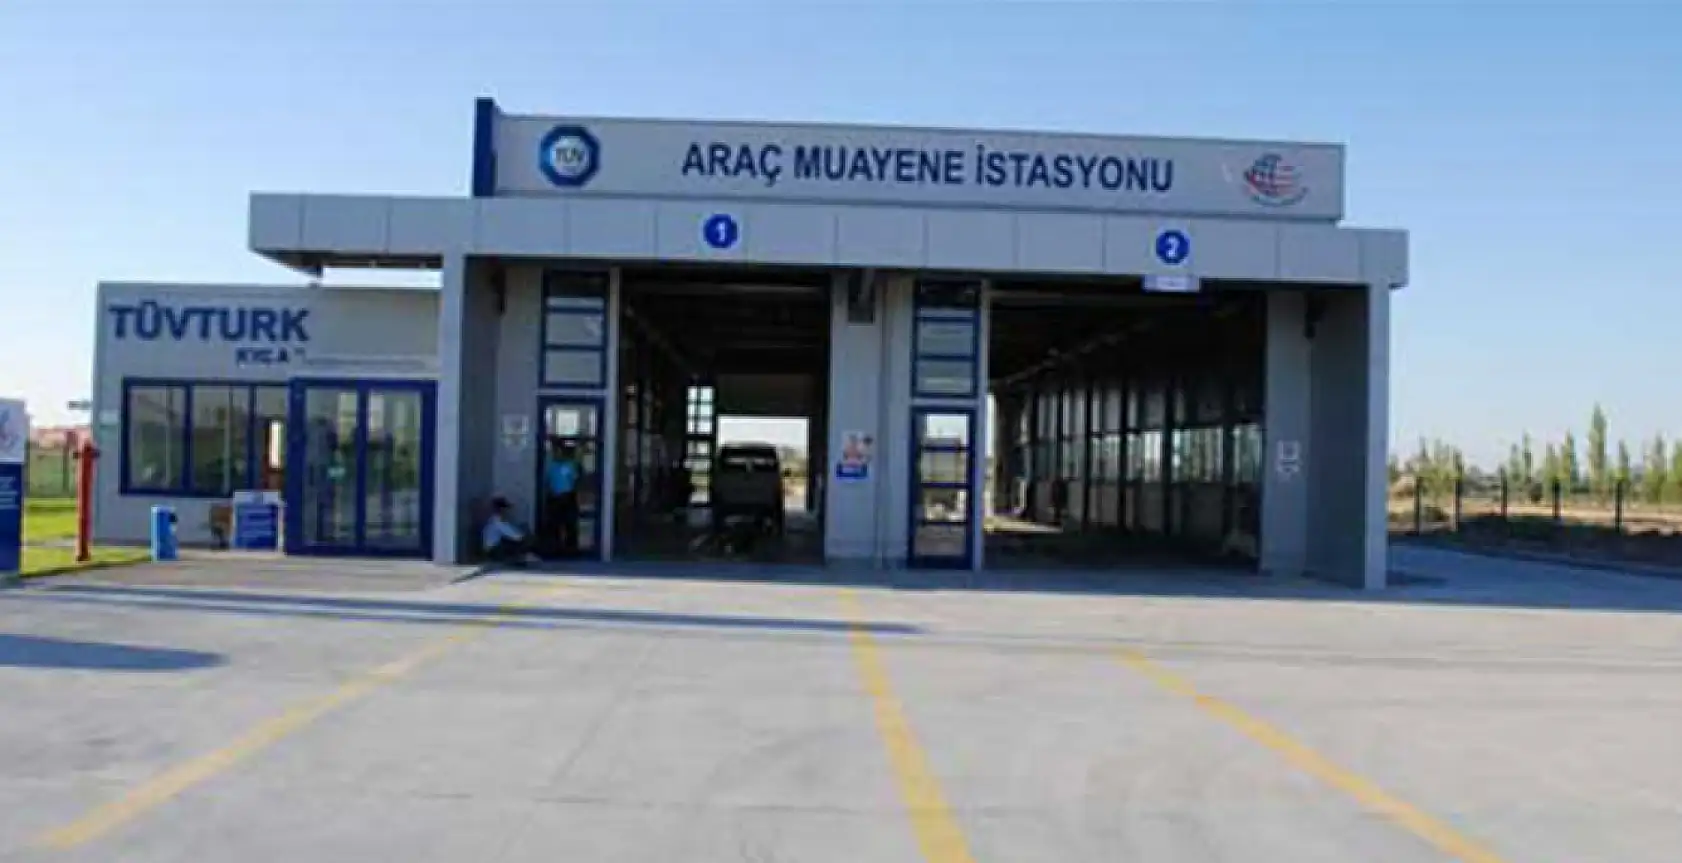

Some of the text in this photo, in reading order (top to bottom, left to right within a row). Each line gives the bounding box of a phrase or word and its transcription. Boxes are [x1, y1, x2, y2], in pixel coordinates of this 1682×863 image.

[682, 142, 1173, 191] ARAÇ MUAYENE İSTASYONU
[713, 222, 727, 243] 1
[1164, 236, 1181, 258] 2
[109, 300, 311, 343] TÜVTURK
